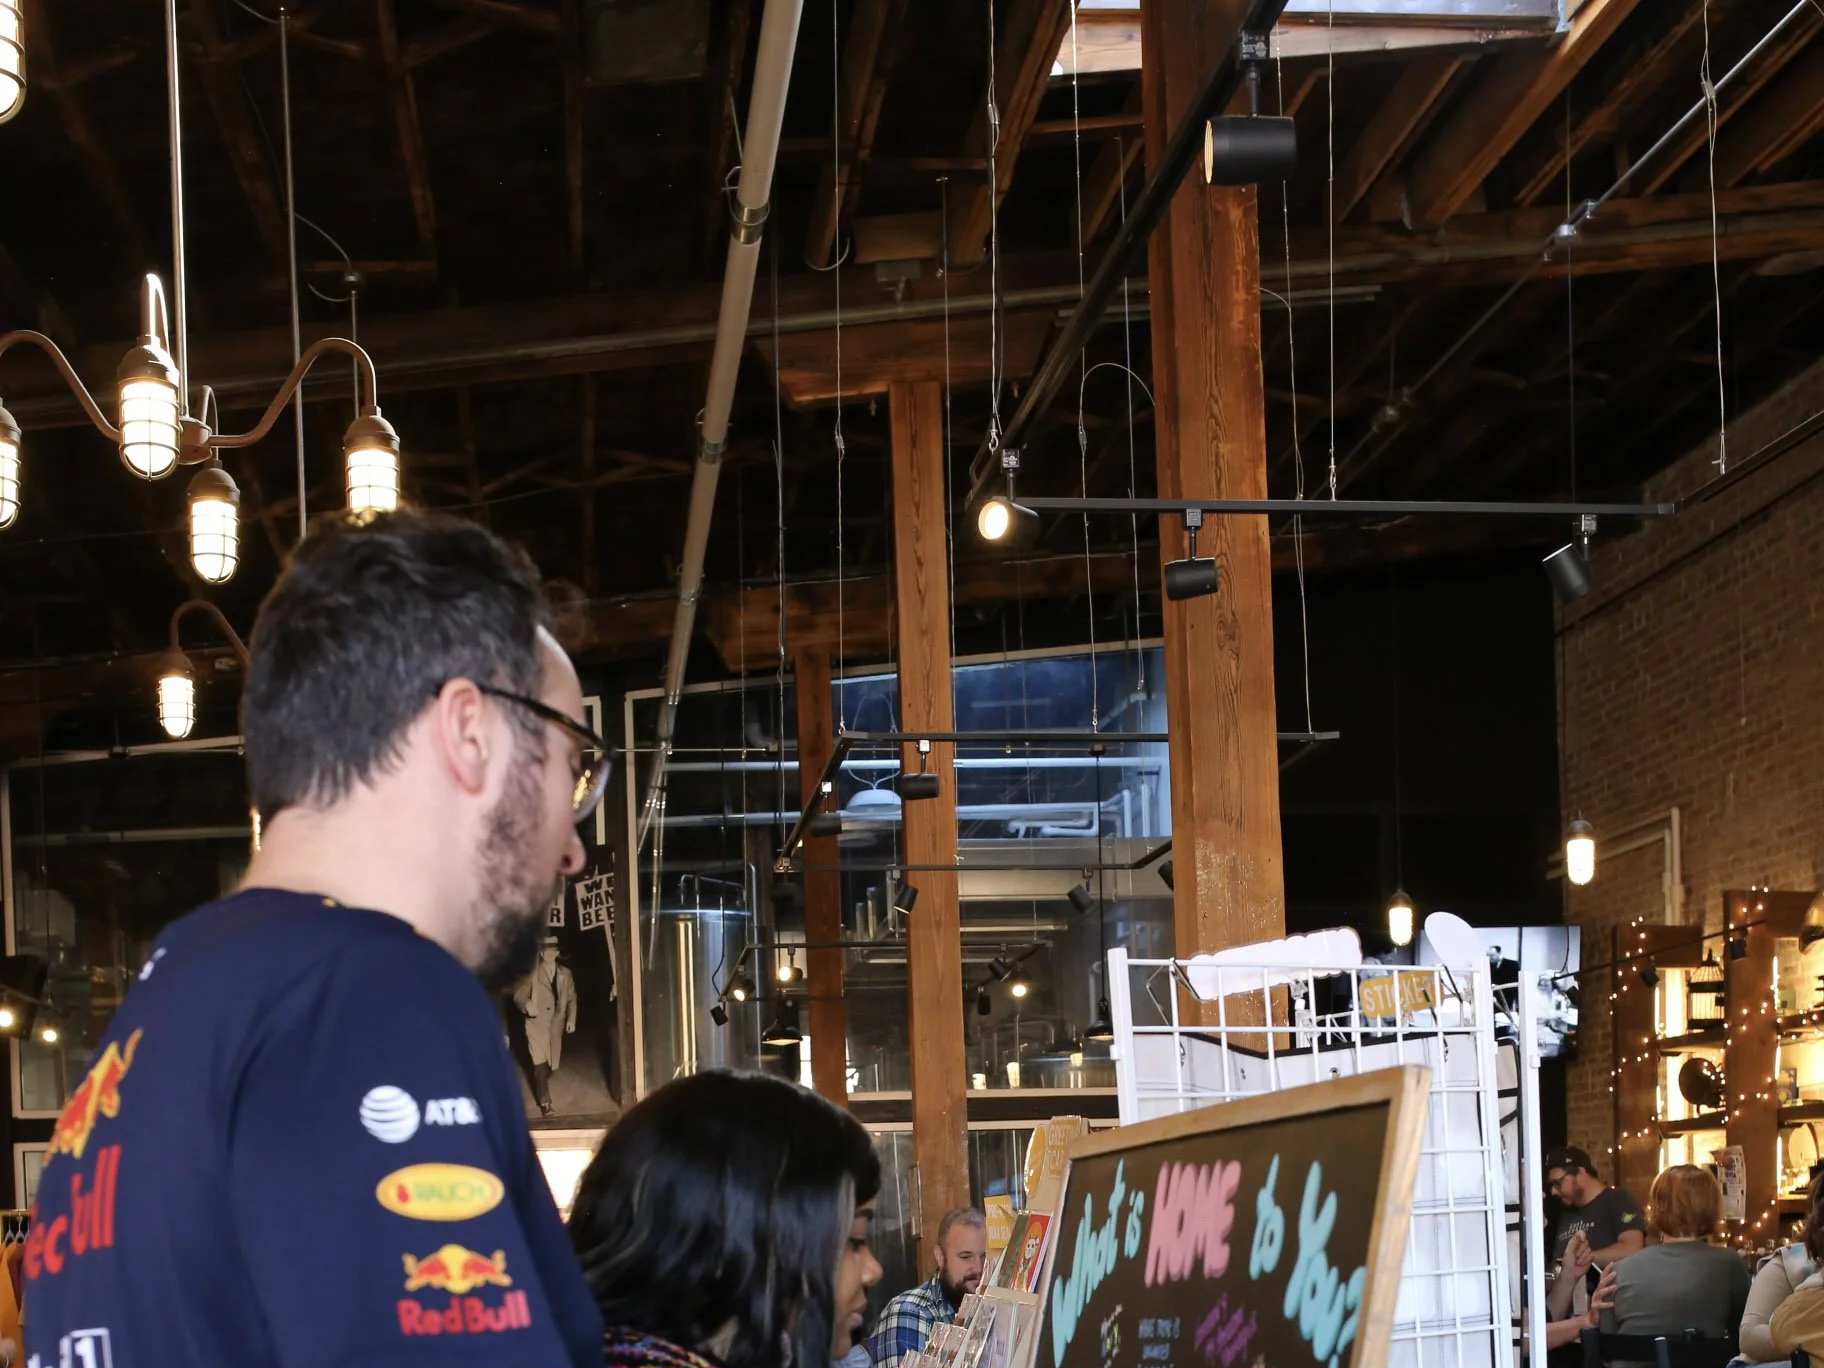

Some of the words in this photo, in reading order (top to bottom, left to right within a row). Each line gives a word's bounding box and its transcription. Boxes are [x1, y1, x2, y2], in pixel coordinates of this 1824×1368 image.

[396, 1296, 462, 1335] Red
[462, 1289, 531, 1332] Bull
[1052, 1158, 1125, 1368] What
[1124, 1189, 1144, 1259] is
[1144, 1159, 1241, 1288] HOME
[1249, 1153, 1284, 1280] to
